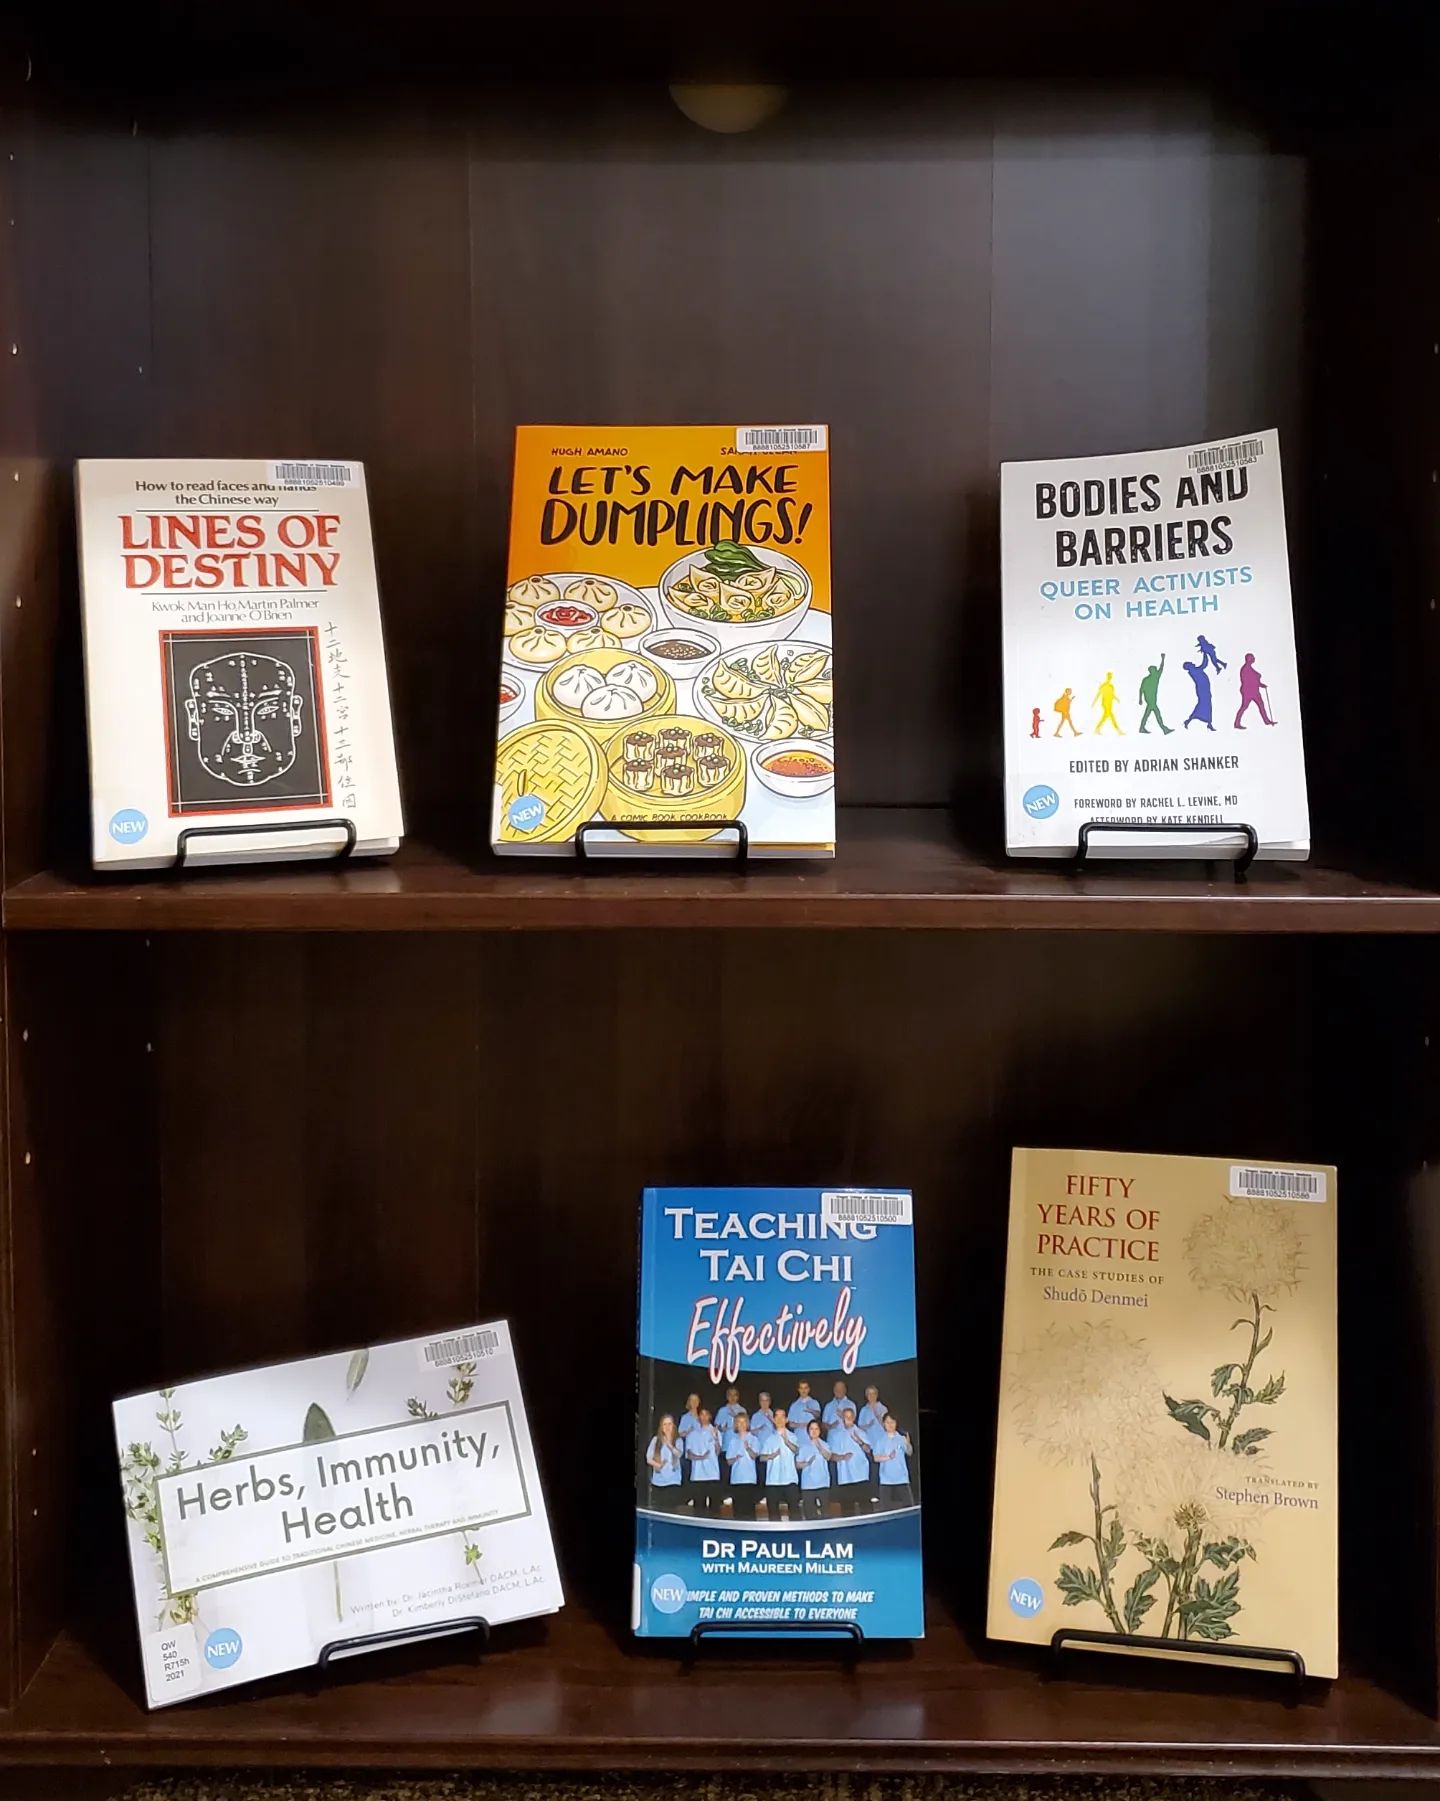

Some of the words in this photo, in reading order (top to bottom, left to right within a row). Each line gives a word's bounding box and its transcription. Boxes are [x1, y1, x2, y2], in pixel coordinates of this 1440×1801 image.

[551, 447, 582, 456] HUGH
[587, 447, 628, 456] AMANO
[135, 480, 167, 491] How
[169, 482, 183, 491] to
[186, 480, 215, 491] read
[217, 480, 250, 491] faces
[548, 464, 651, 496] LET'S
[670, 464, 799, 496] MAKE
[176, 494, 198, 506] the
[200, 494, 252, 506] Chinese
[254, 496, 279, 508] way
[1035, 473, 1161, 520] BODIES
[1175, 466, 1249, 508] AND
[540, 496, 813, 546] DUMPLINGS!
[118, 515, 266, 550] LINES
[277, 515, 341, 548] OF
[1055, 515, 1234, 568] BARRIERS
[120, 552, 341, 588] DESTINY
[1040, 578, 1120, 600] QUEER
[1134, 566, 1253, 594] ACTIVISTS
[152, 600, 185, 612] Kwok
[188, 600, 216, 611] Man
[279, 598, 320, 610] Palmer
[1074, 602, 1111, 620] ON
[1126, 595, 1219, 618] HEALTH
[181, 612, 204, 623] and
[206, 611, 247, 623] Joanne
[1069, 760, 1110, 774] EDITED
[1114, 760, 1129, 773] BY
[1133, 758, 1179, 772] ADRIAN
[1183, 756, 1240, 771] SHANKER
[1025, 792, 1056, 814] NEW
[1074, 798, 1123, 808] FOREWORD
[1126, 798, 1137, 808] BY
[1140, 797, 1174, 808] RACHEL
[1177, 797, 1186, 807] L.
[1188, 796, 1222, 807] LEVINE,
[1224, 795, 1238, 806] MD
[511, 803, 542, 824] NEW
[112, 820, 146, 834] NEW
[1066, 1174, 1136, 1198] FIFTY
[664, 1206, 878, 1240] TEACHING
[1037, 1203, 1115, 1226] YEARS
[1126, 1209, 1160, 1230] OF
[1036, 1233, 1160, 1262] PRACTICE
[1030, 1267, 1054, 1277] THE
[1058, 1268, 1088, 1279] CASE
[1092, 1271, 1145, 1284] STUDIES
[1148, 1274, 1165, 1285] OF
[1043, 1286, 1088, 1304] Shudō
[1091, 1290, 1148, 1308] Denmei
[686, 1286, 866, 1385] Effectively
[176, 1464, 305, 1521] Herbs,
[316, 1429, 500, 1488] Immunity,
[1246, 1476, 1305, 1488] TRANSLATED
[1215, 1486, 1269, 1505] Stephen
[1274, 1492, 1319, 1509] Brown
[282, 1482, 413, 1542] Health
[702, 1540, 736, 1558] DR
[741, 1540, 800, 1559] PAUL
[805, 1540, 854, 1559] LAM
[702, 1562, 735, 1574] WITH
[738, 1562, 801, 1574] MAUREEN
[806, 1562, 854, 1574] MILLER
[653, 1588, 684, 1601] NEW
[686, 1590, 718, 1602] IMPLE
[718, 1590, 740, 1602] AND
[742, 1590, 782, 1603] PROVEN
[782, 1591, 829, 1603] METHODS
[831, 1591, 844, 1602] TO
[846, 1591, 874, 1602] MAKE
[1010, 1588, 1042, 1611] NEW
[699, 1607, 715, 1619] TAI
[716, 1607, 734, 1619] CHI
[734, 1607, 790, 1620] ACCESSIBLE
[793, 1608, 806, 1620] TO
[808, 1608, 858, 1620] EVERYONE
[161, 1640, 176, 1651] QW
[207, 1640, 240, 1658] NEW
[162, 1651, 178, 1661] 540
[164, 1658, 190, 1671] R715h
[166, 1670, 185, 1682] 2021
